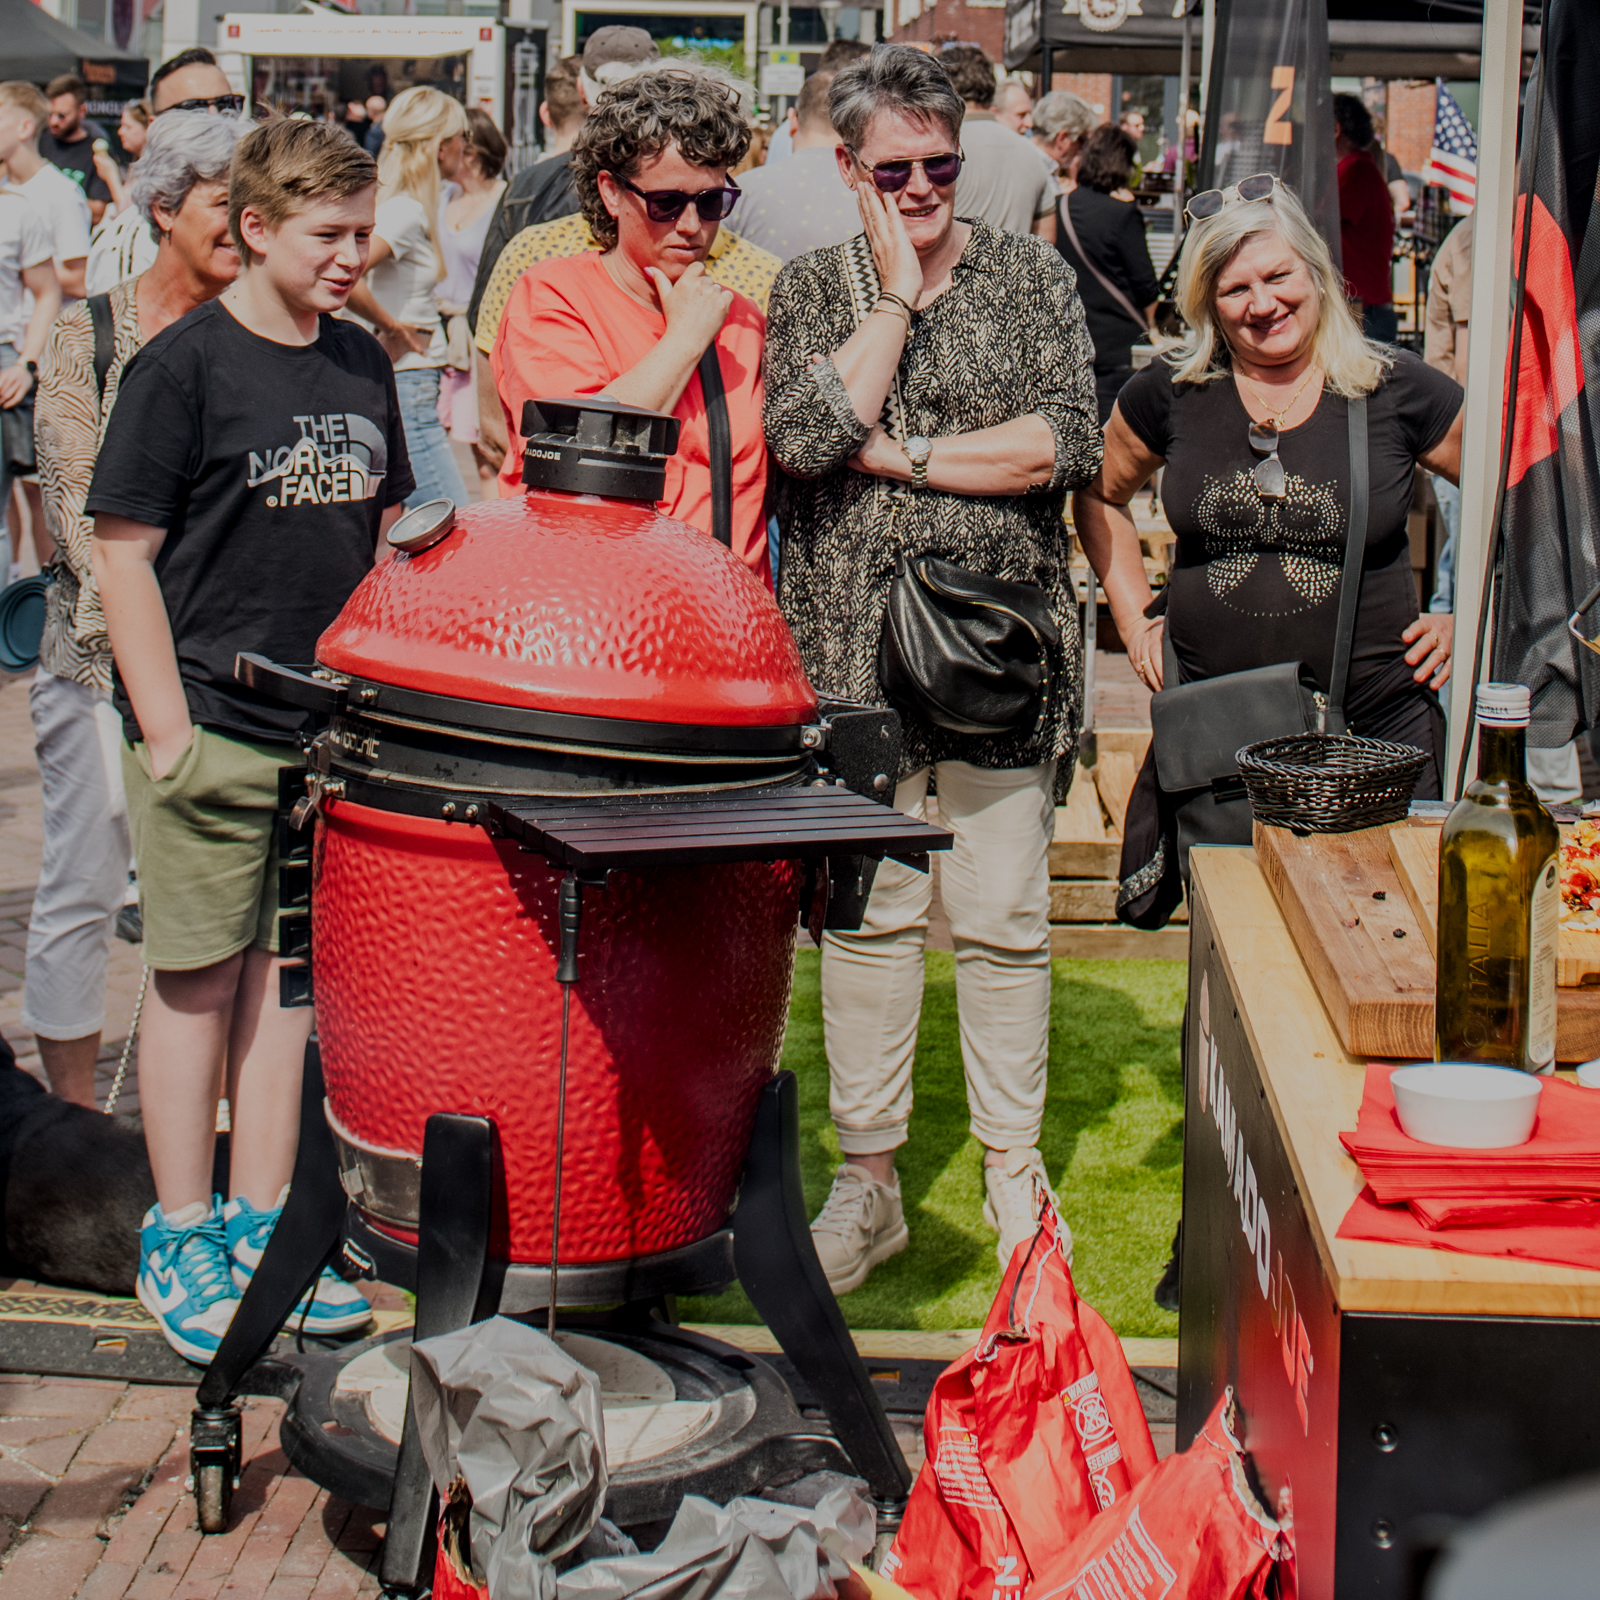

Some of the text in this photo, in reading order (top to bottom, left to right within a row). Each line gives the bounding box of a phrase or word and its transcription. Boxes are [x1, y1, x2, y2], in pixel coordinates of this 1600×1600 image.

[293, 413, 348, 443] THE
[248, 442, 349, 480] NORTH
[279, 471, 351, 507] FACE
